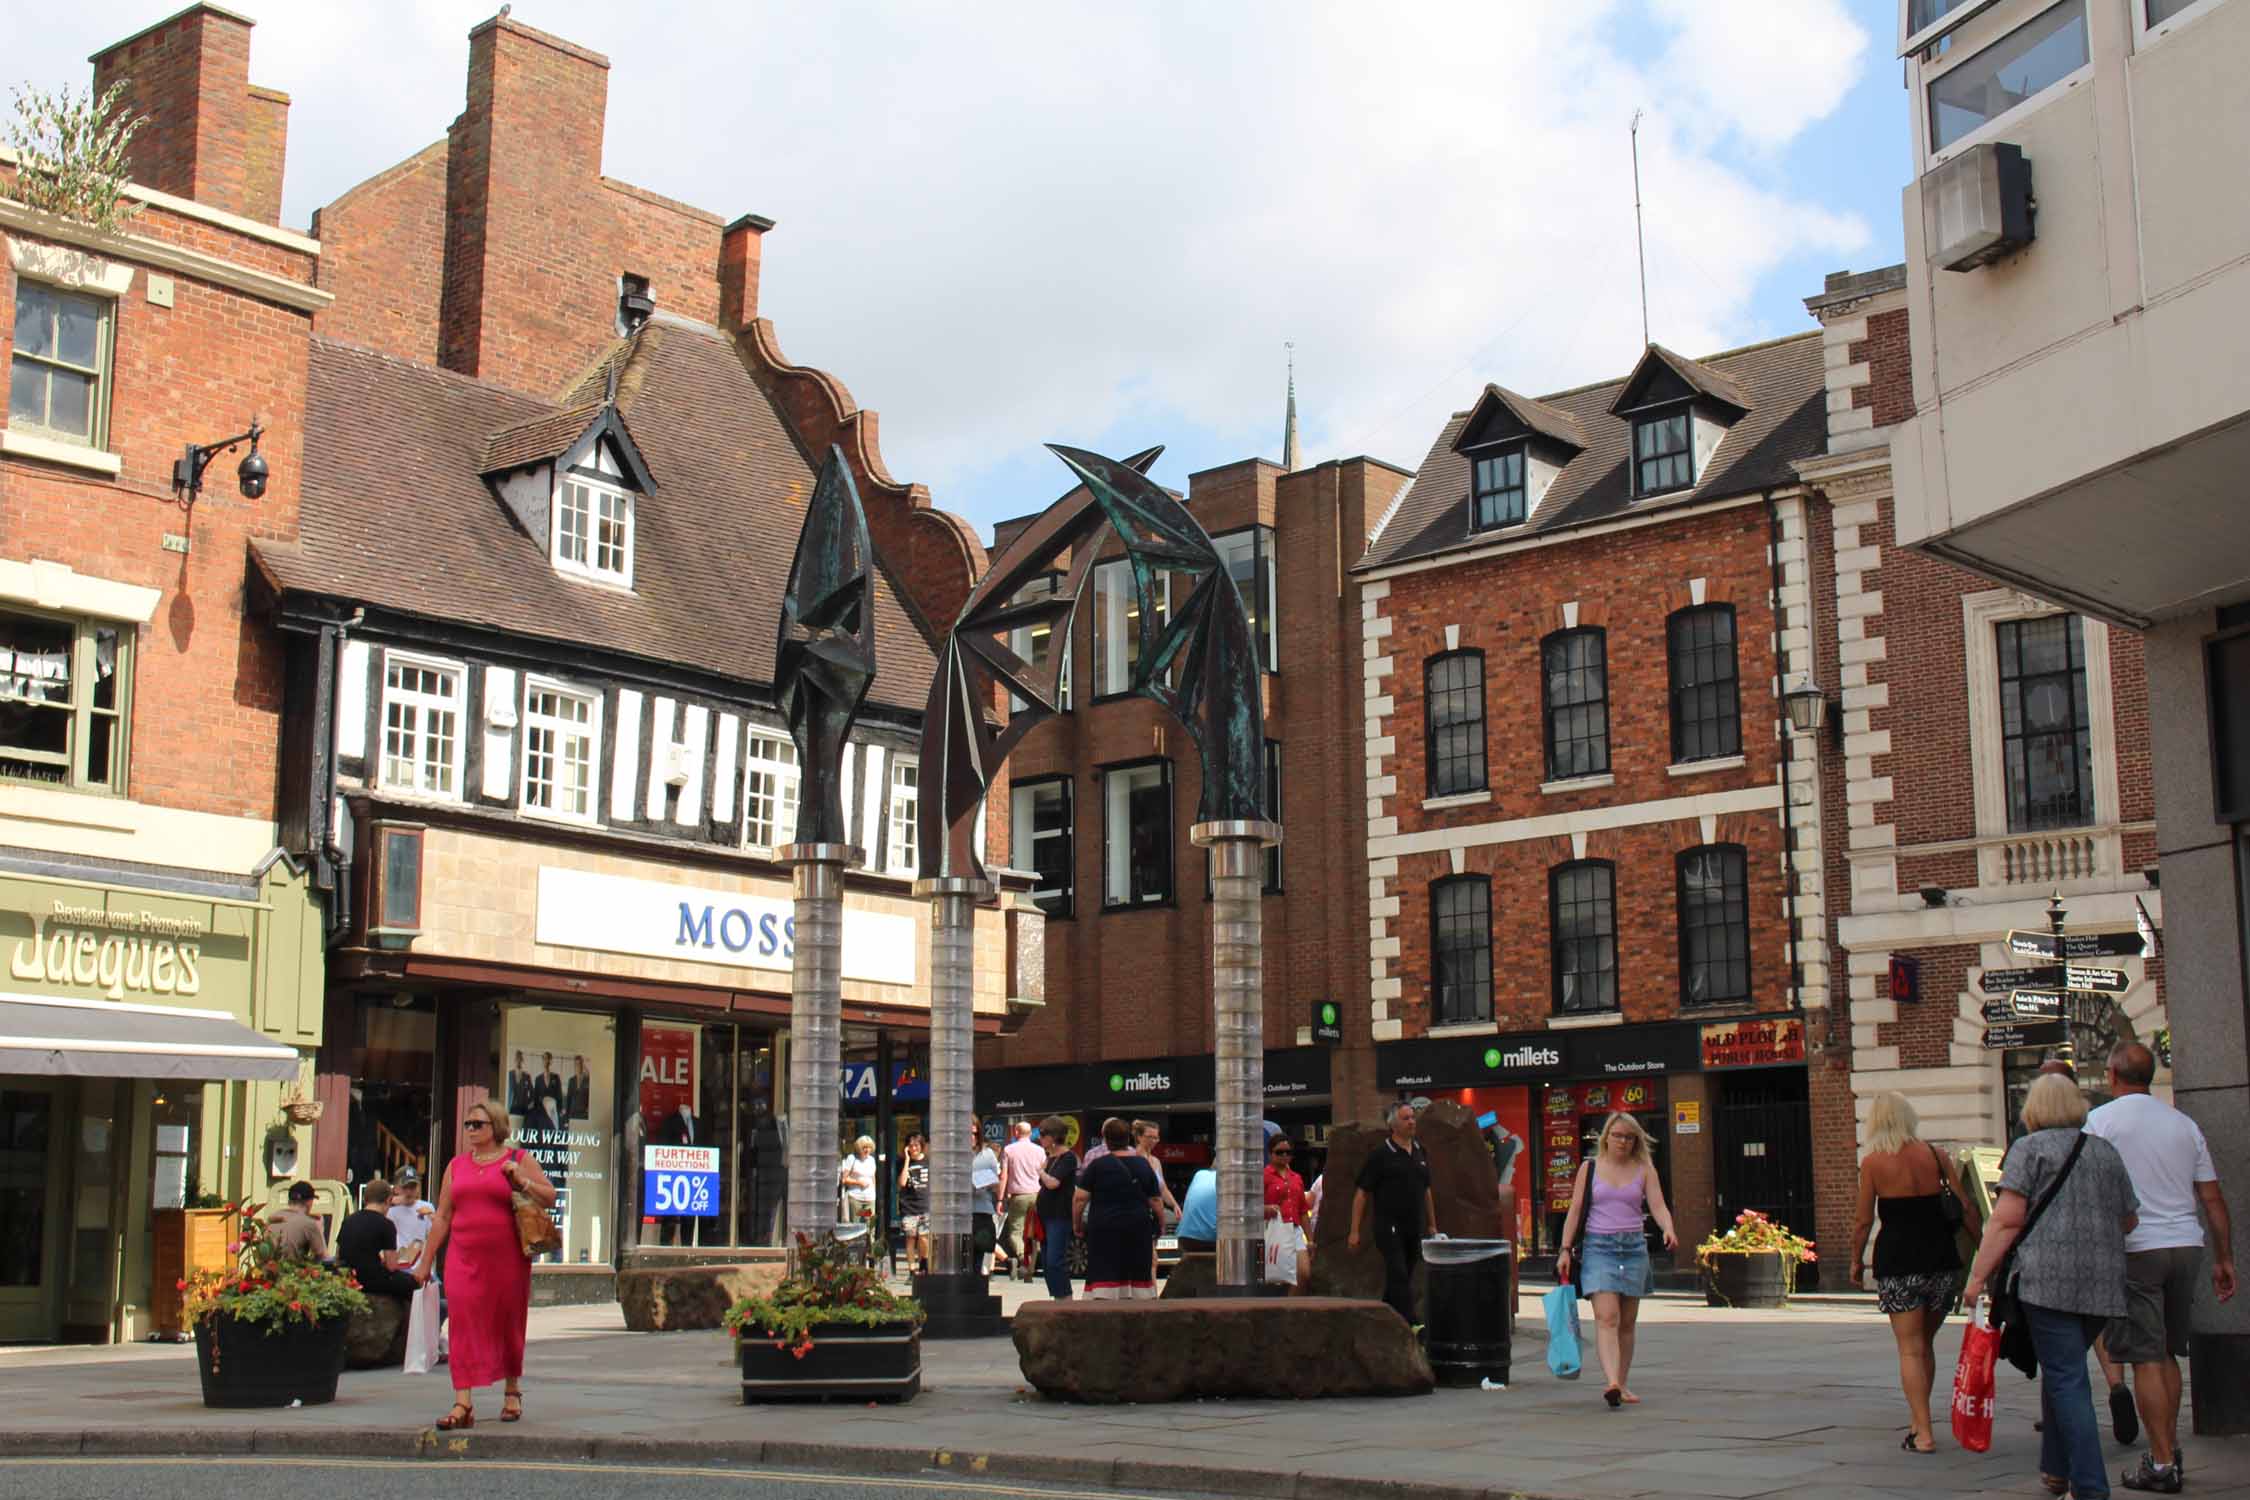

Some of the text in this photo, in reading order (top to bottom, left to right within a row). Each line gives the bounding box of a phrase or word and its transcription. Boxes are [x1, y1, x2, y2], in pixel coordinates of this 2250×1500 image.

[53, 899, 135, 931] Restaurant
[675, 902, 794, 959] MOSS
[11, 908, 201, 1000] Jacques
[1318, 1027, 1340, 1038] millets
[1739, 1028, 1799, 1045] PLOUH
[1503, 1046, 1559, 1068] millets
[640, 1056, 688, 1085] ALE
[1604, 1060, 1665, 1072] The Outdoor Store
[1125, 1073, 1170, 1091] millets
[1396, 1075, 1432, 1085] millets.co.uk
[541, 1129, 601, 1147] WEDDING
[557, 1150, 582, 1165] WAY
[655, 1148, 710, 1161] FURTHER
[655, 1160, 710, 1170] REDUCTIONS
[656, 1174, 709, 1211] 50%
[691, 1201, 709, 1211] OFF
